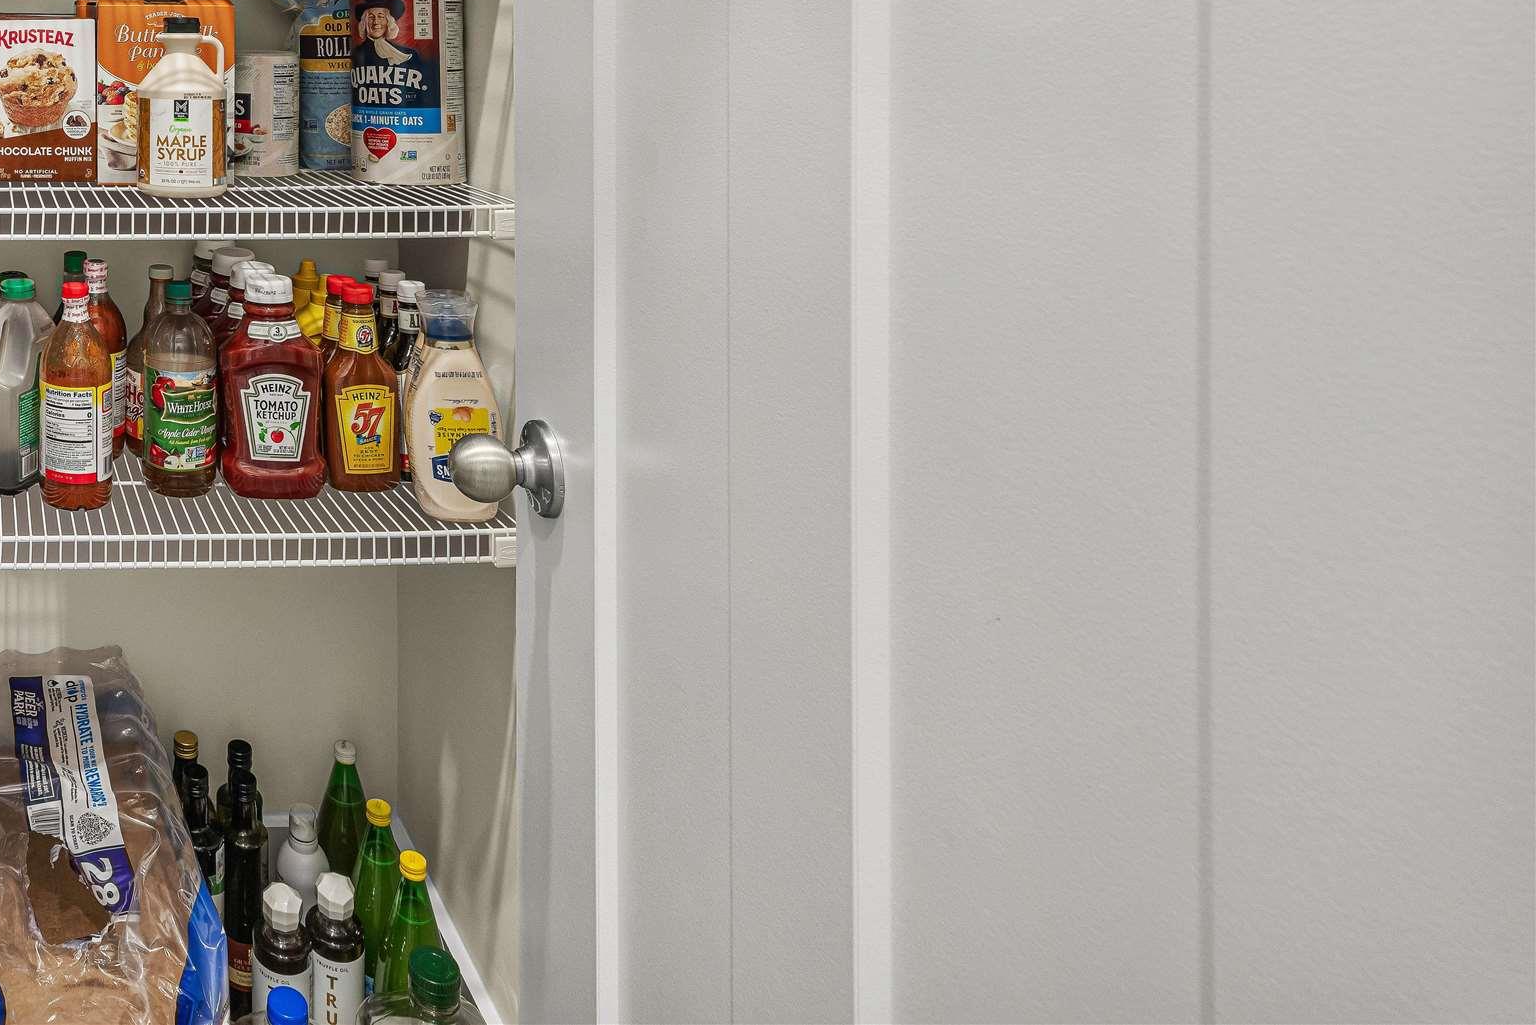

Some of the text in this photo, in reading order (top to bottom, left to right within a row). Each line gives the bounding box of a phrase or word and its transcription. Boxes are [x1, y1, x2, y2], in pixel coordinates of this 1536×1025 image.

[325, 23, 342, 32] OLD
[359, 87, 402, 104] OATS
[364, 115, 423, 126] 1-MINUTE OATS
[156, 134, 207, 147] MAPLE
[55, 146, 93, 156] CHUNK
[158, 148, 206, 161] SYRUP
[46, 388, 92, 398] Nutrition Facts
[261, 384, 292, 395] HEINZ
[352, 392, 381, 401] HEINZ
[254, 400, 298, 411] TOMATO
[256, 411, 297, 420] KETCHUP
[351, 402, 386, 437] 57
[13, 690, 25, 715] PARK
[24, 692, 38, 717] DEER
[75, 704, 94, 745] HYDRATE
[81, 857, 120, 906] 28
[315, 958, 338, 973] TRUFFLE
